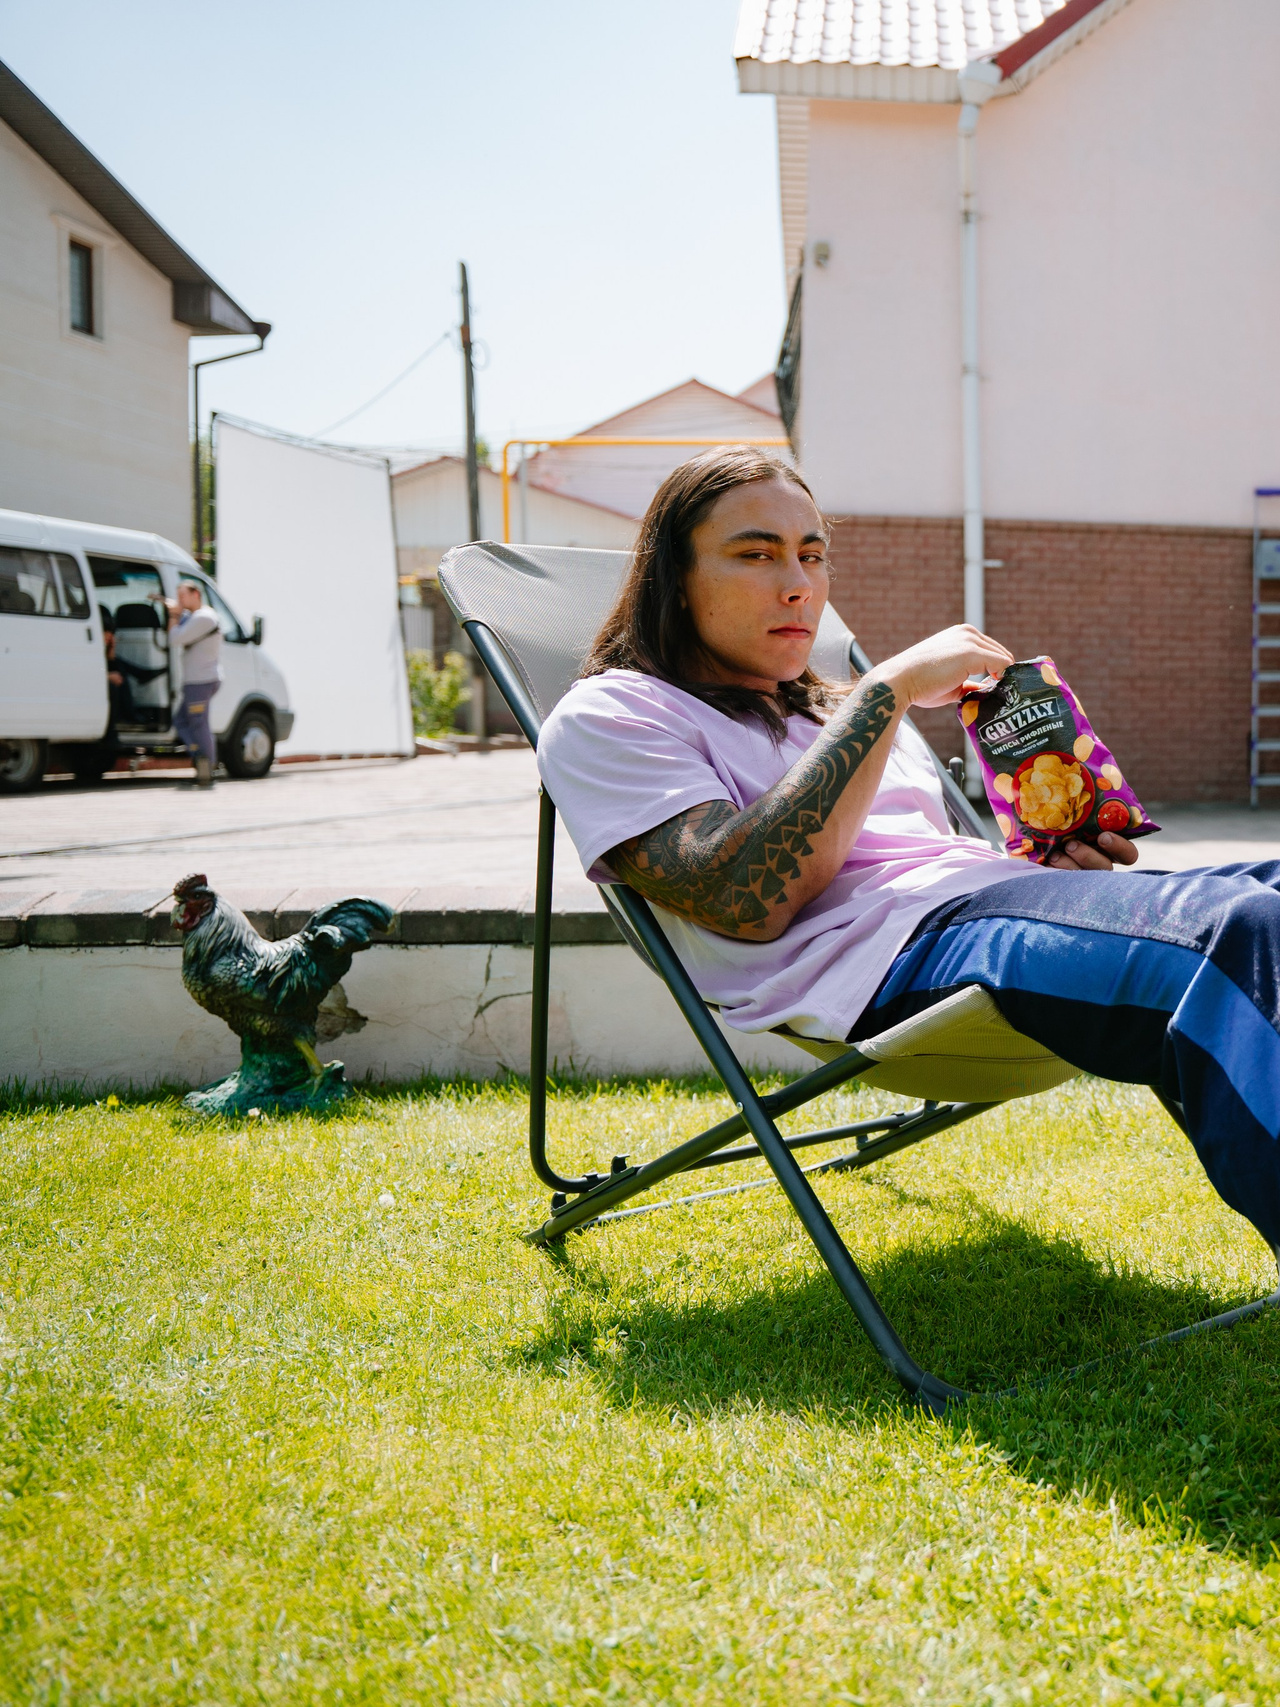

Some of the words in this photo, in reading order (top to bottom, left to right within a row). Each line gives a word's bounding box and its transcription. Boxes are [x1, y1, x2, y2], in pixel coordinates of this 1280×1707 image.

[985, 701, 1055, 741] GRIZZLY
[991, 739, 1020, 755] ЧИПСЫ
[1019, 720, 1064, 743] РИФЛЕНЫЕ
